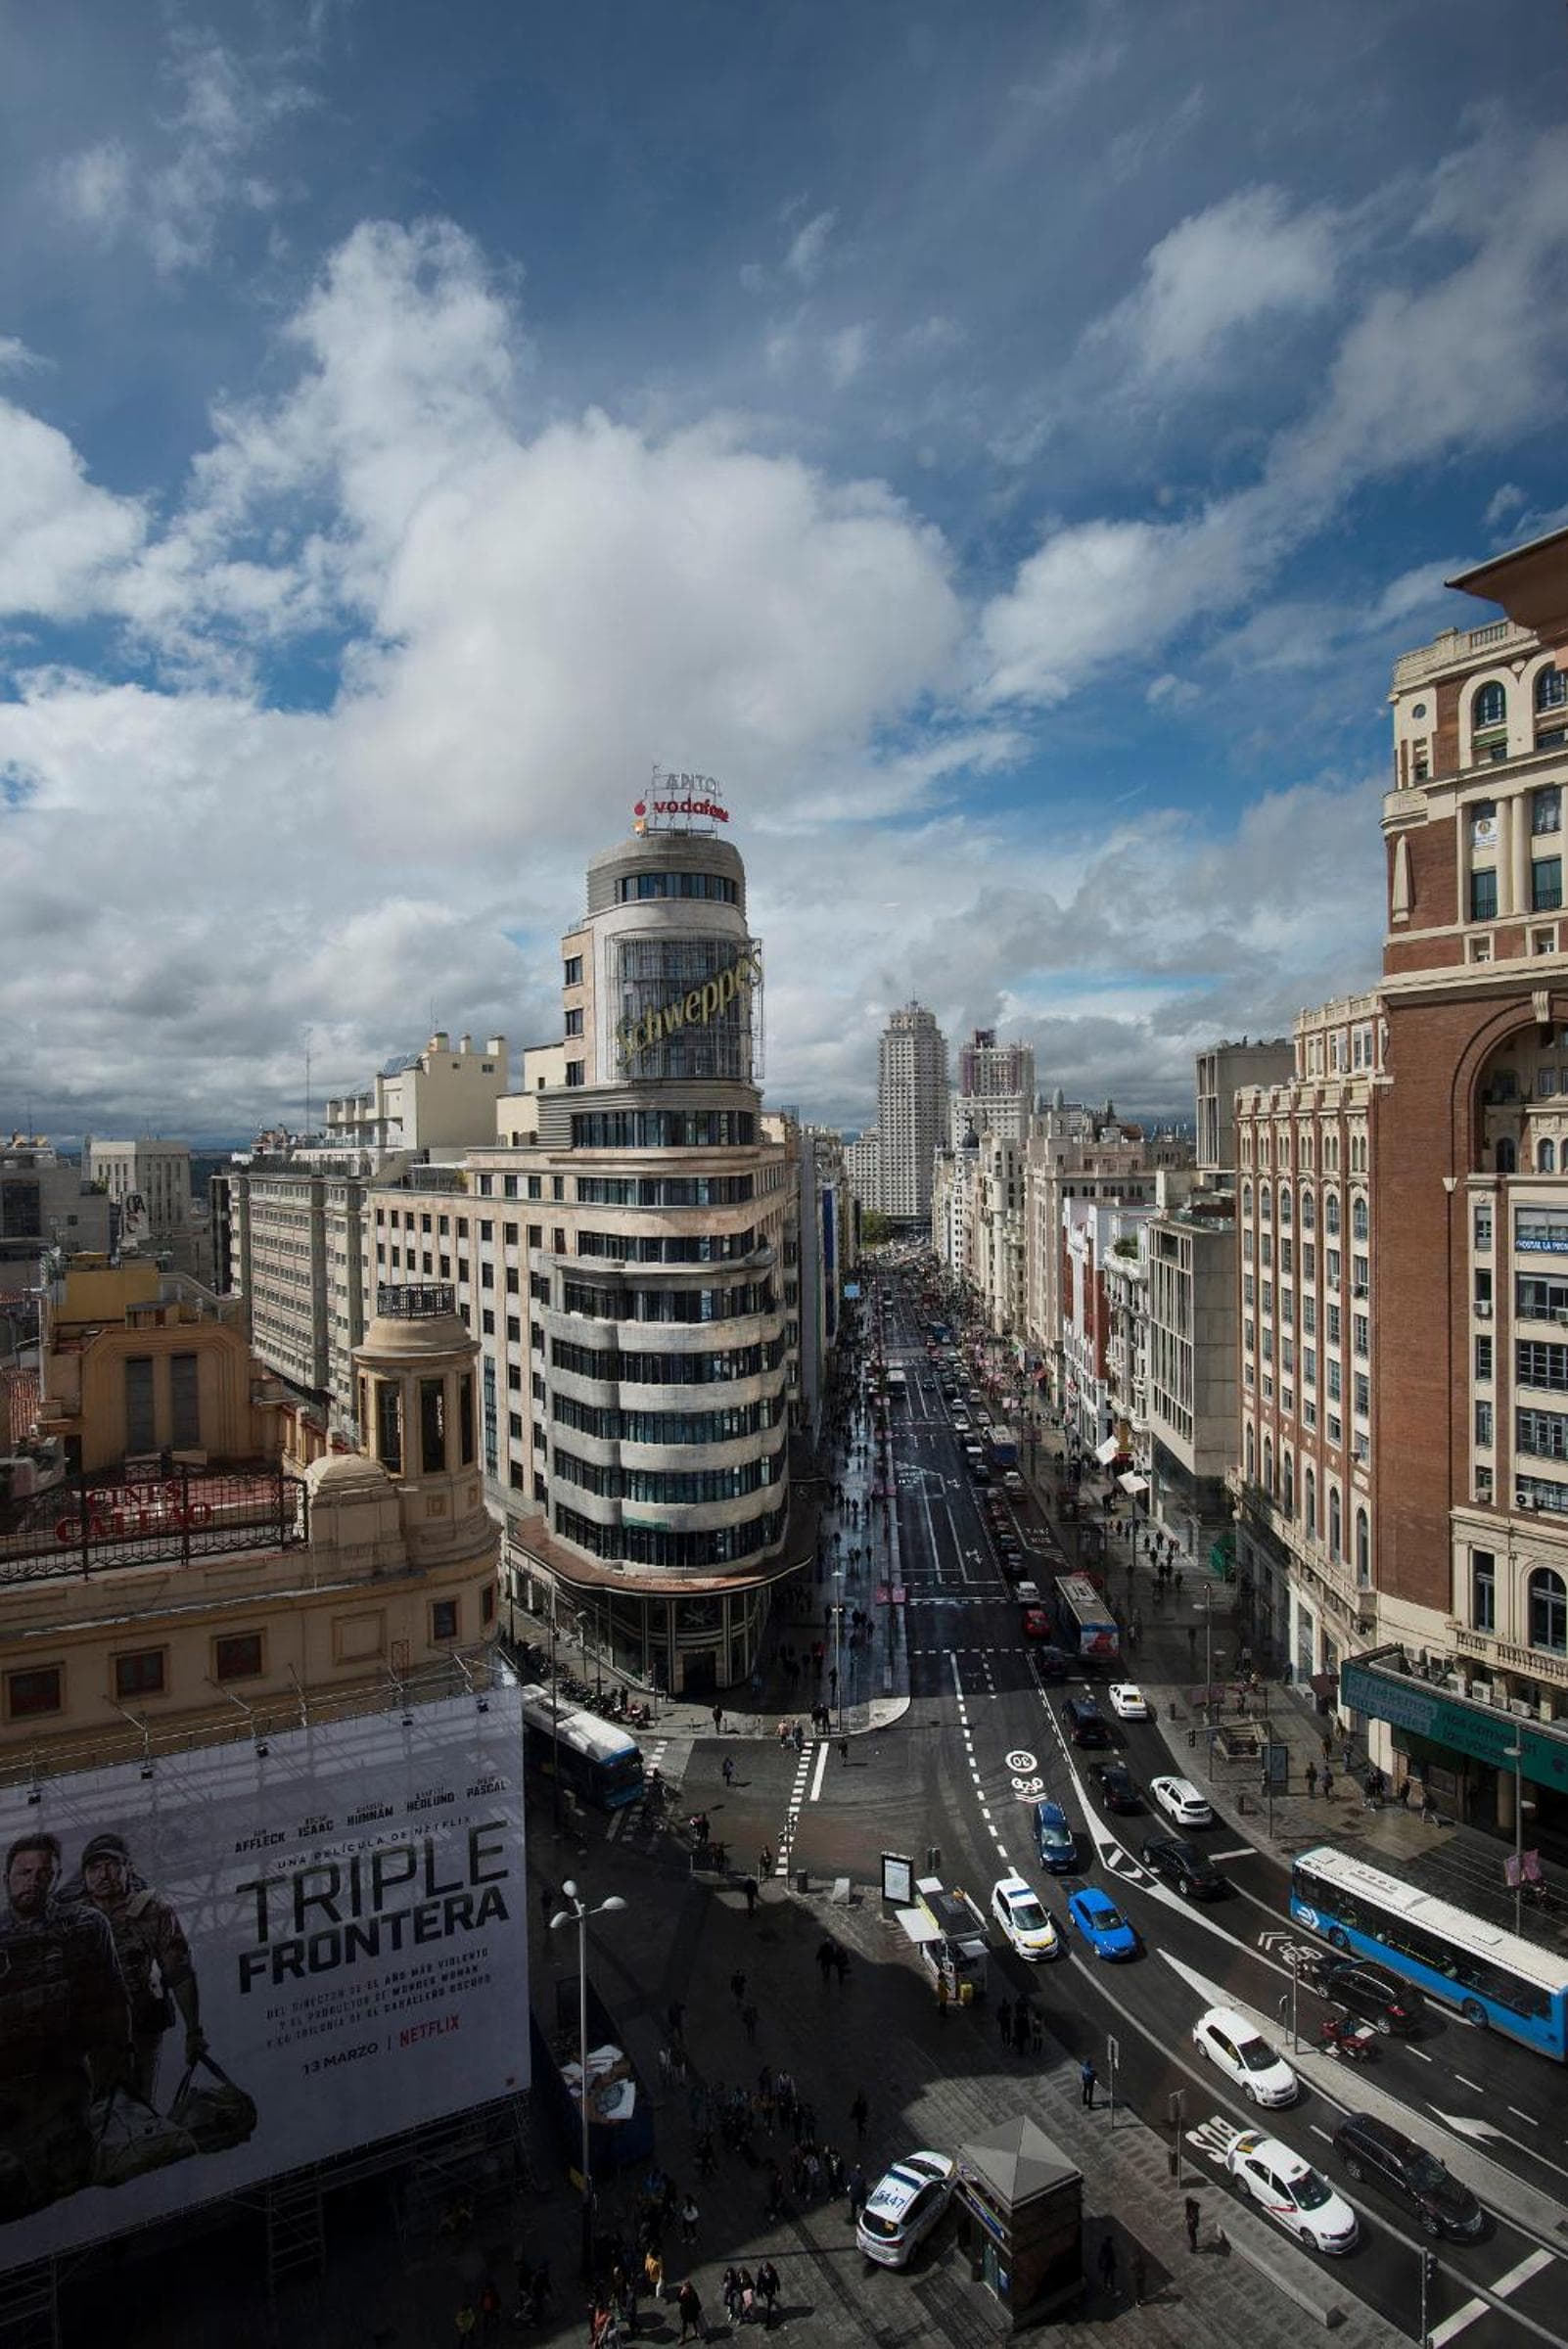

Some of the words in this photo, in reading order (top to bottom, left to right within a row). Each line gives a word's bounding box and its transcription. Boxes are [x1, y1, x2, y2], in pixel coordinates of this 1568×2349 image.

[654, 798, 729, 822] vodafone
[617, 947, 762, 1067] Schweppes
[235, 1832, 285, 1853] AFFLECK
[299, 1820, 334, 1837] ISAAC
[467, 1779, 507, 1798] PASCAL
[236, 1819, 509, 1943] TRIPLE
[239, 1885, 510, 1994] FRONTERA
[302, 2060, 320, 2076] 13
[324, 2043, 379, 2068] MARZO
[399, 2014, 460, 2049] NETFLIX
